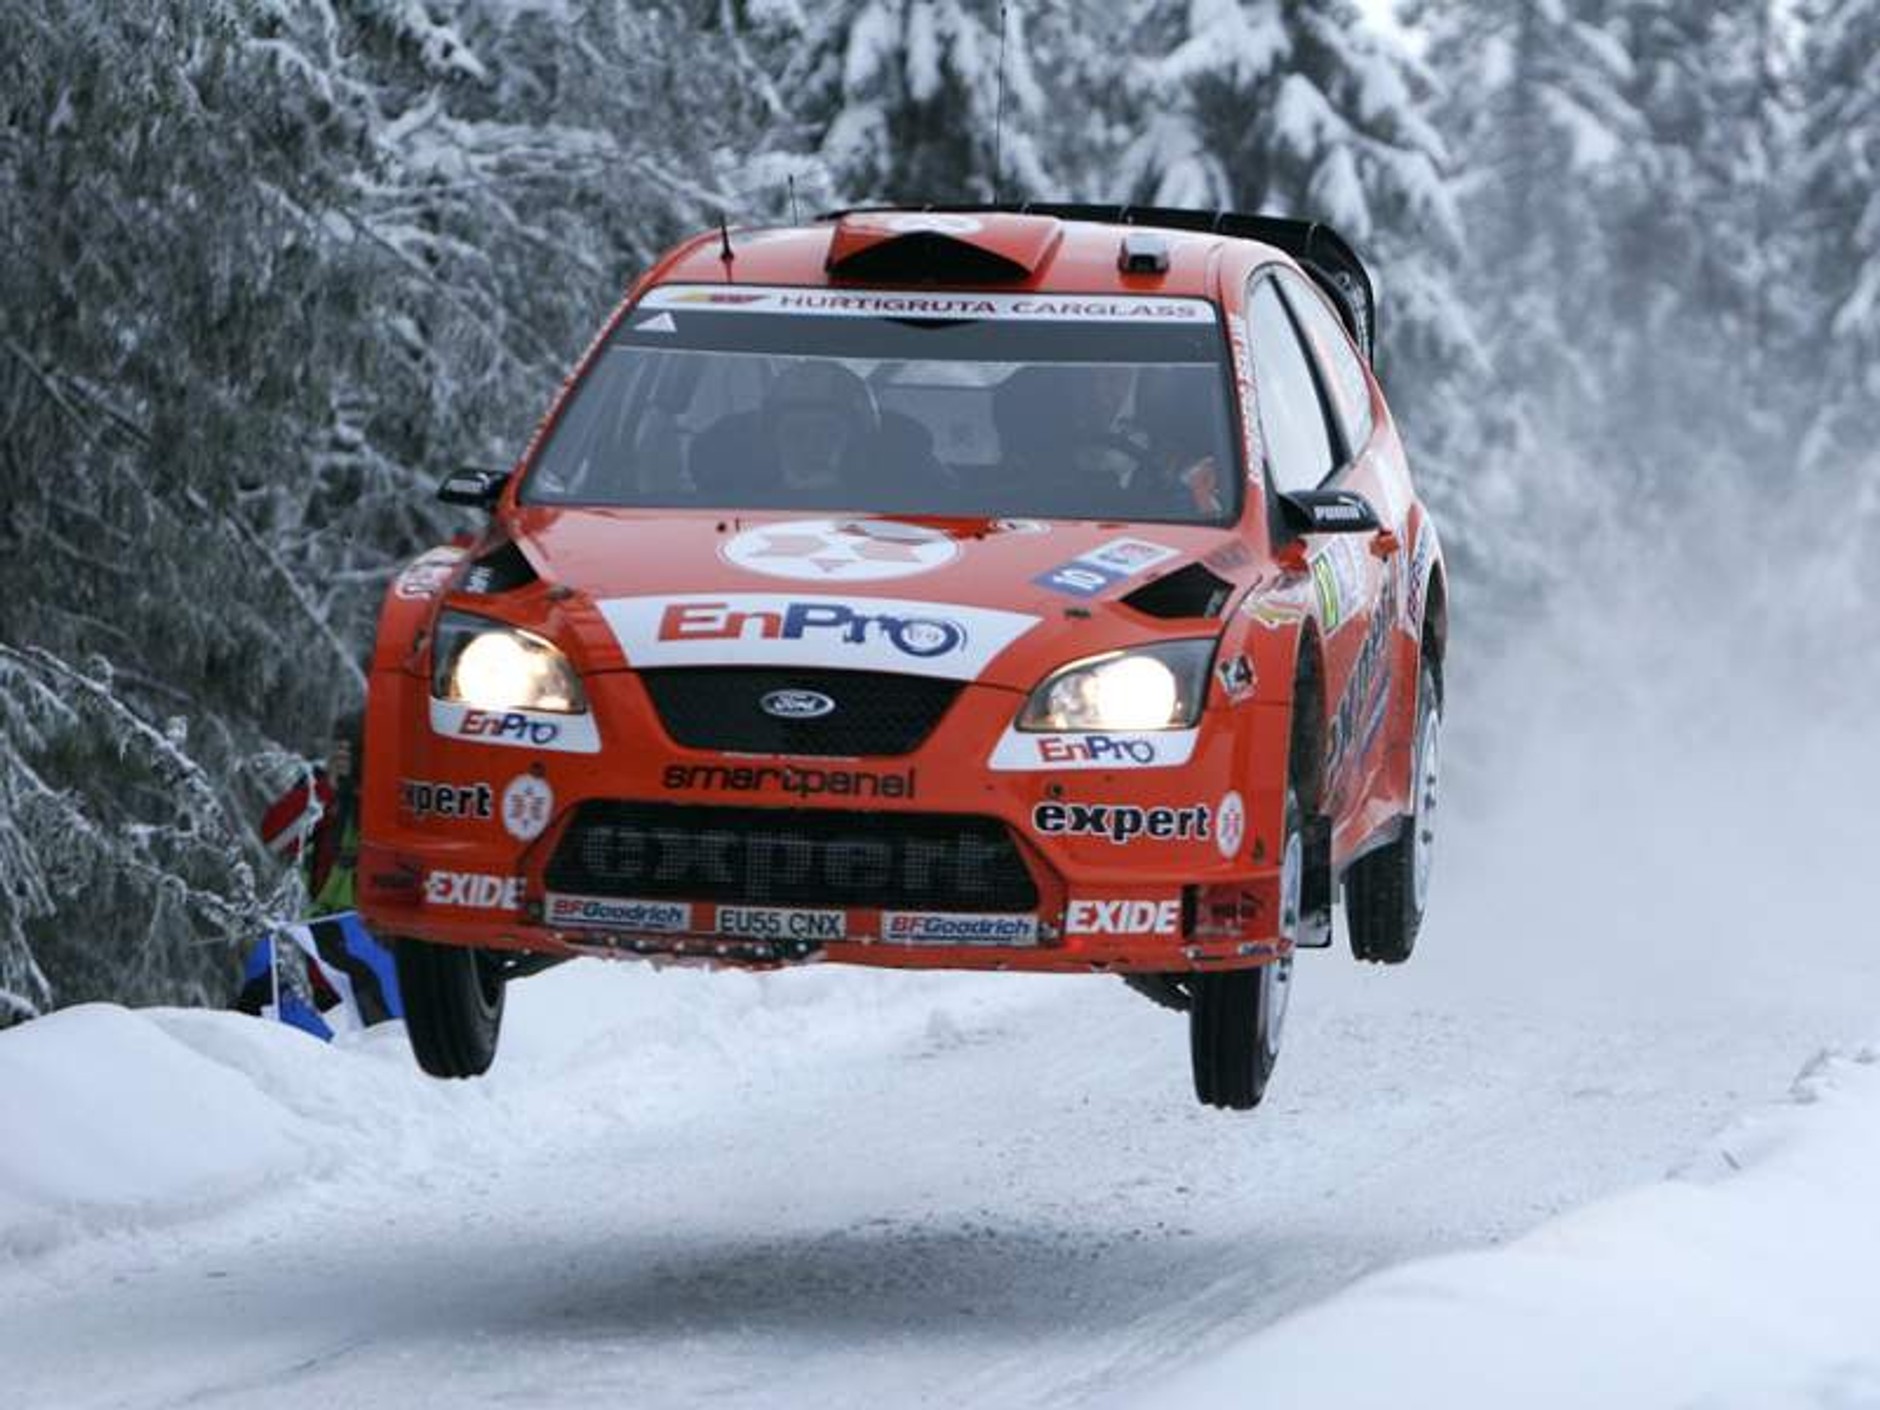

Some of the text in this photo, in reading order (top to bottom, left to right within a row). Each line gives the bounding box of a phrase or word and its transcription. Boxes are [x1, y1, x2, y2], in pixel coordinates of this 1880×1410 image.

[780, 295, 1196, 317] HURTIGRUTA CARGLASS
[658, 602, 962, 657] EnPro
[459, 710, 558, 743] EnPro
[1037, 736, 1156, 762] EnPro
[662, 763, 915, 799] smartpanel
[1033, 801, 1211, 845] expert
[583, 825, 1000, 900] expert
[553, 900, 684, 924] BFGoodrich
[720, 910, 842, 937] EU55 CNX
[890, 915, 1032, 937] BFGoodrich
[1066, 900, 1181, 934] EXIDE
